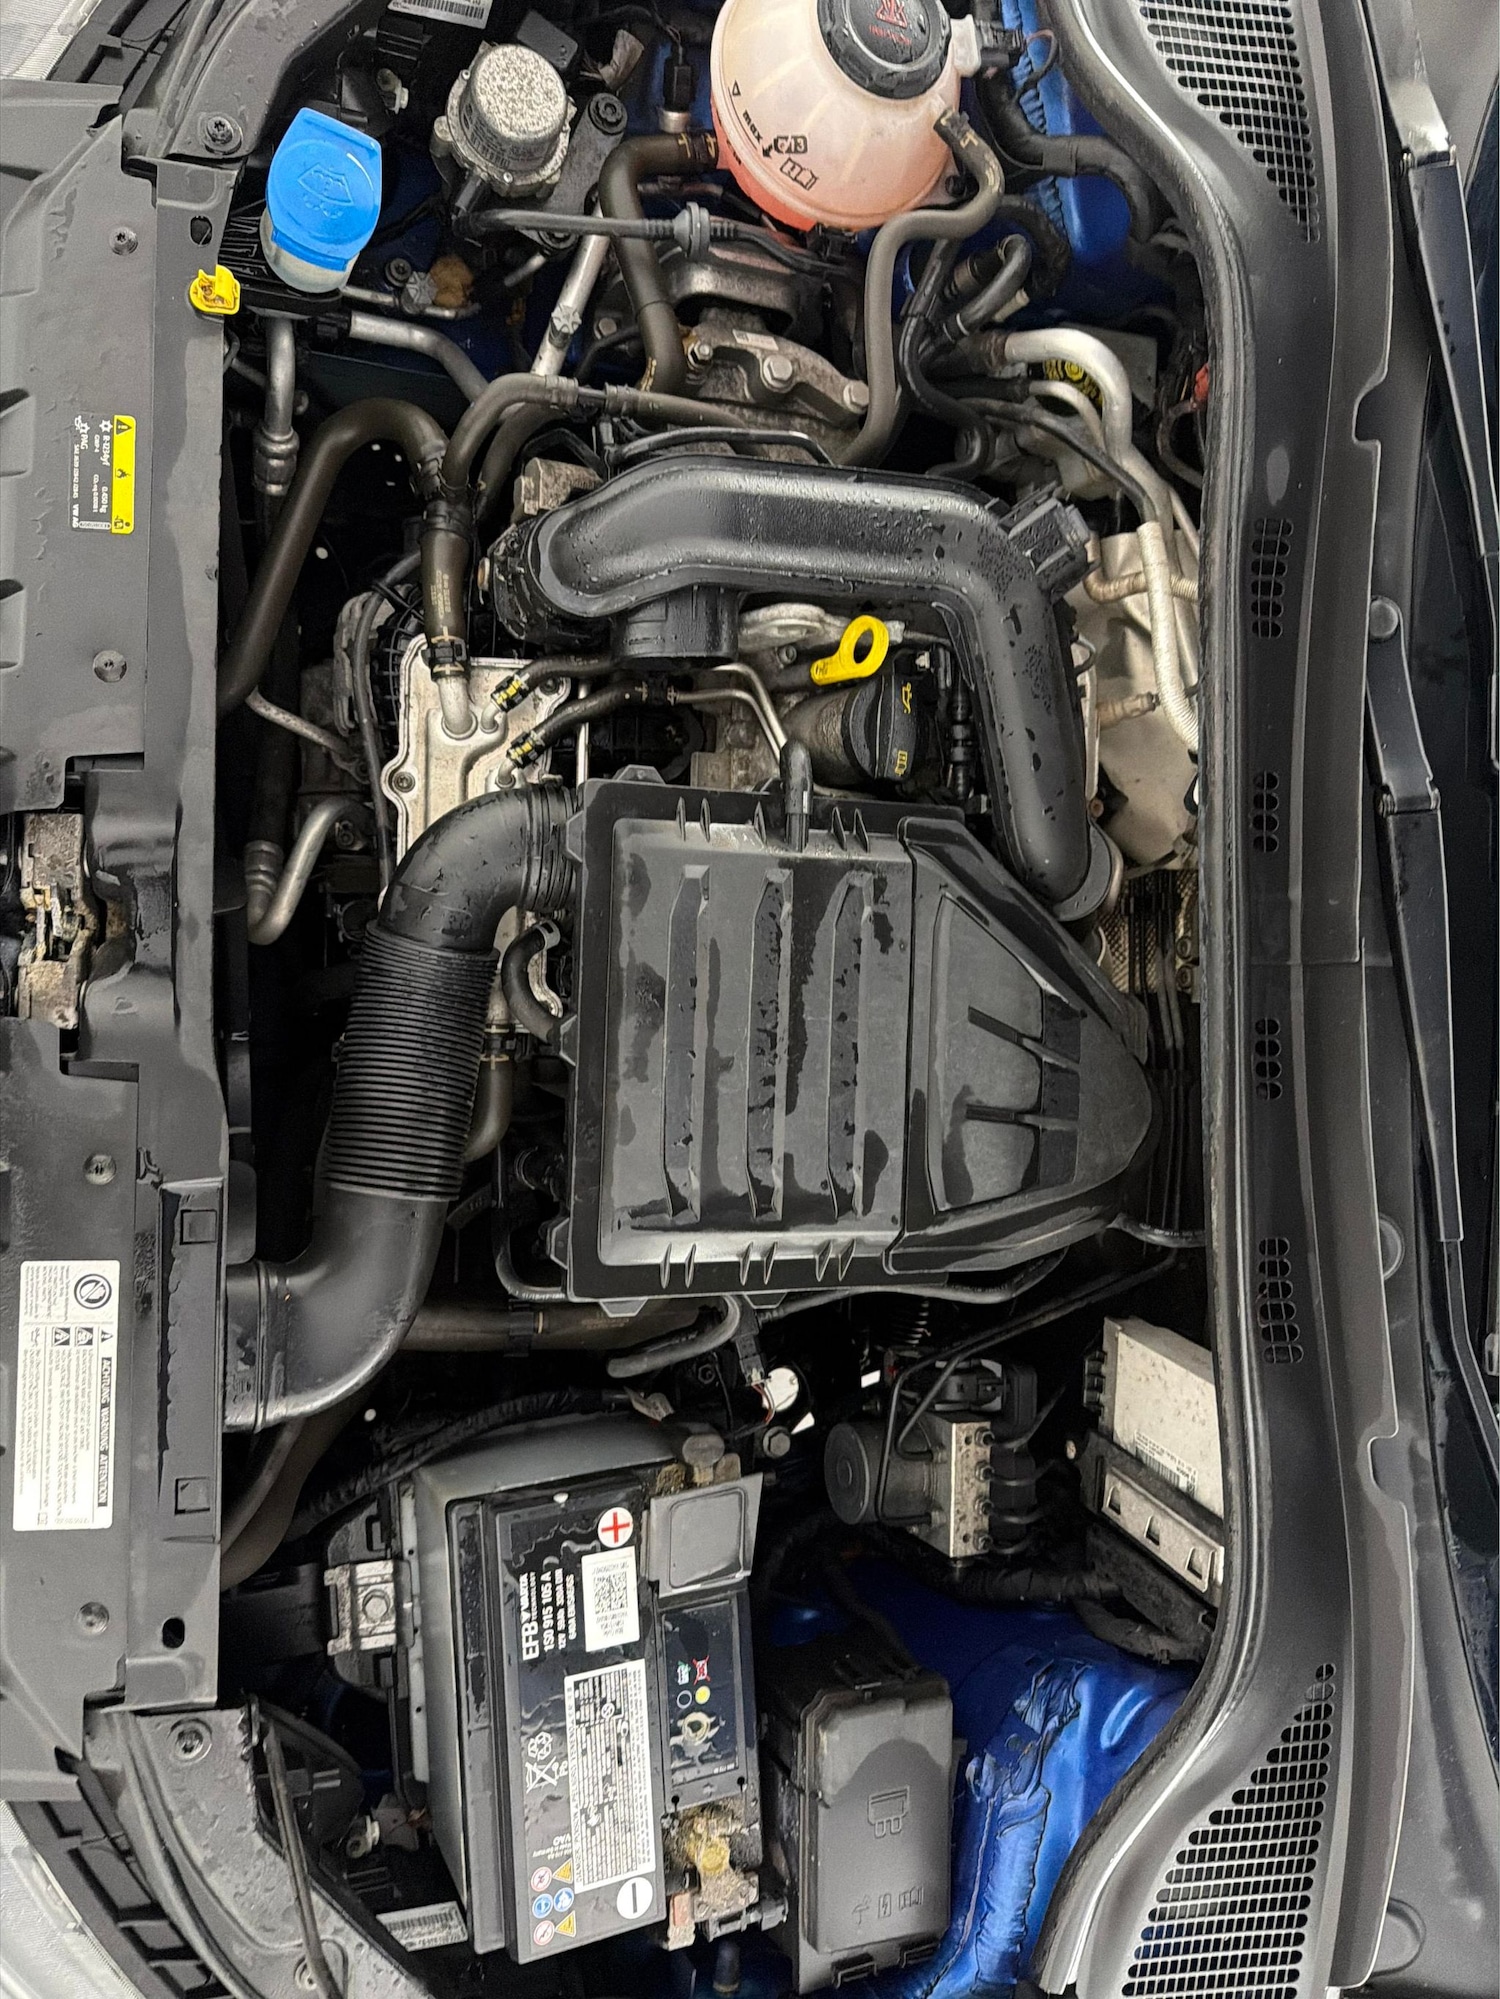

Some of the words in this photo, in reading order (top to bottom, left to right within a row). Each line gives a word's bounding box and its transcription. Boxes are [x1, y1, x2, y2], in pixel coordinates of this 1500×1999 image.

[742, 109, 763, 144] max
[80, 434, 89, 449] PAG
[100, 435, 110, 466] R-1234yf
[72, 504, 79, 516] VW
[100, 504, 108, 514] kg
[72, 517, 79, 528] AG
[102, 1359, 111, 1404] ACHTUNG
[100, 1407, 110, 1451] WARNING
[98, 1454, 108, 1503] ATTENTION
[540, 1571, 552, 1581] A
[519, 1573, 529, 1610] VARTA
[529, 1572, 538, 1621] TECHNOLOGY
[541, 1583, 553, 1604] 105
[542, 1606, 554, 1629] 915
[521, 1621, 540, 1661] EFB
[542, 1629, 555, 1652] 1S0
[558, 1633, 566, 1650] 12V
[552, 1832, 571, 1846] VAG
